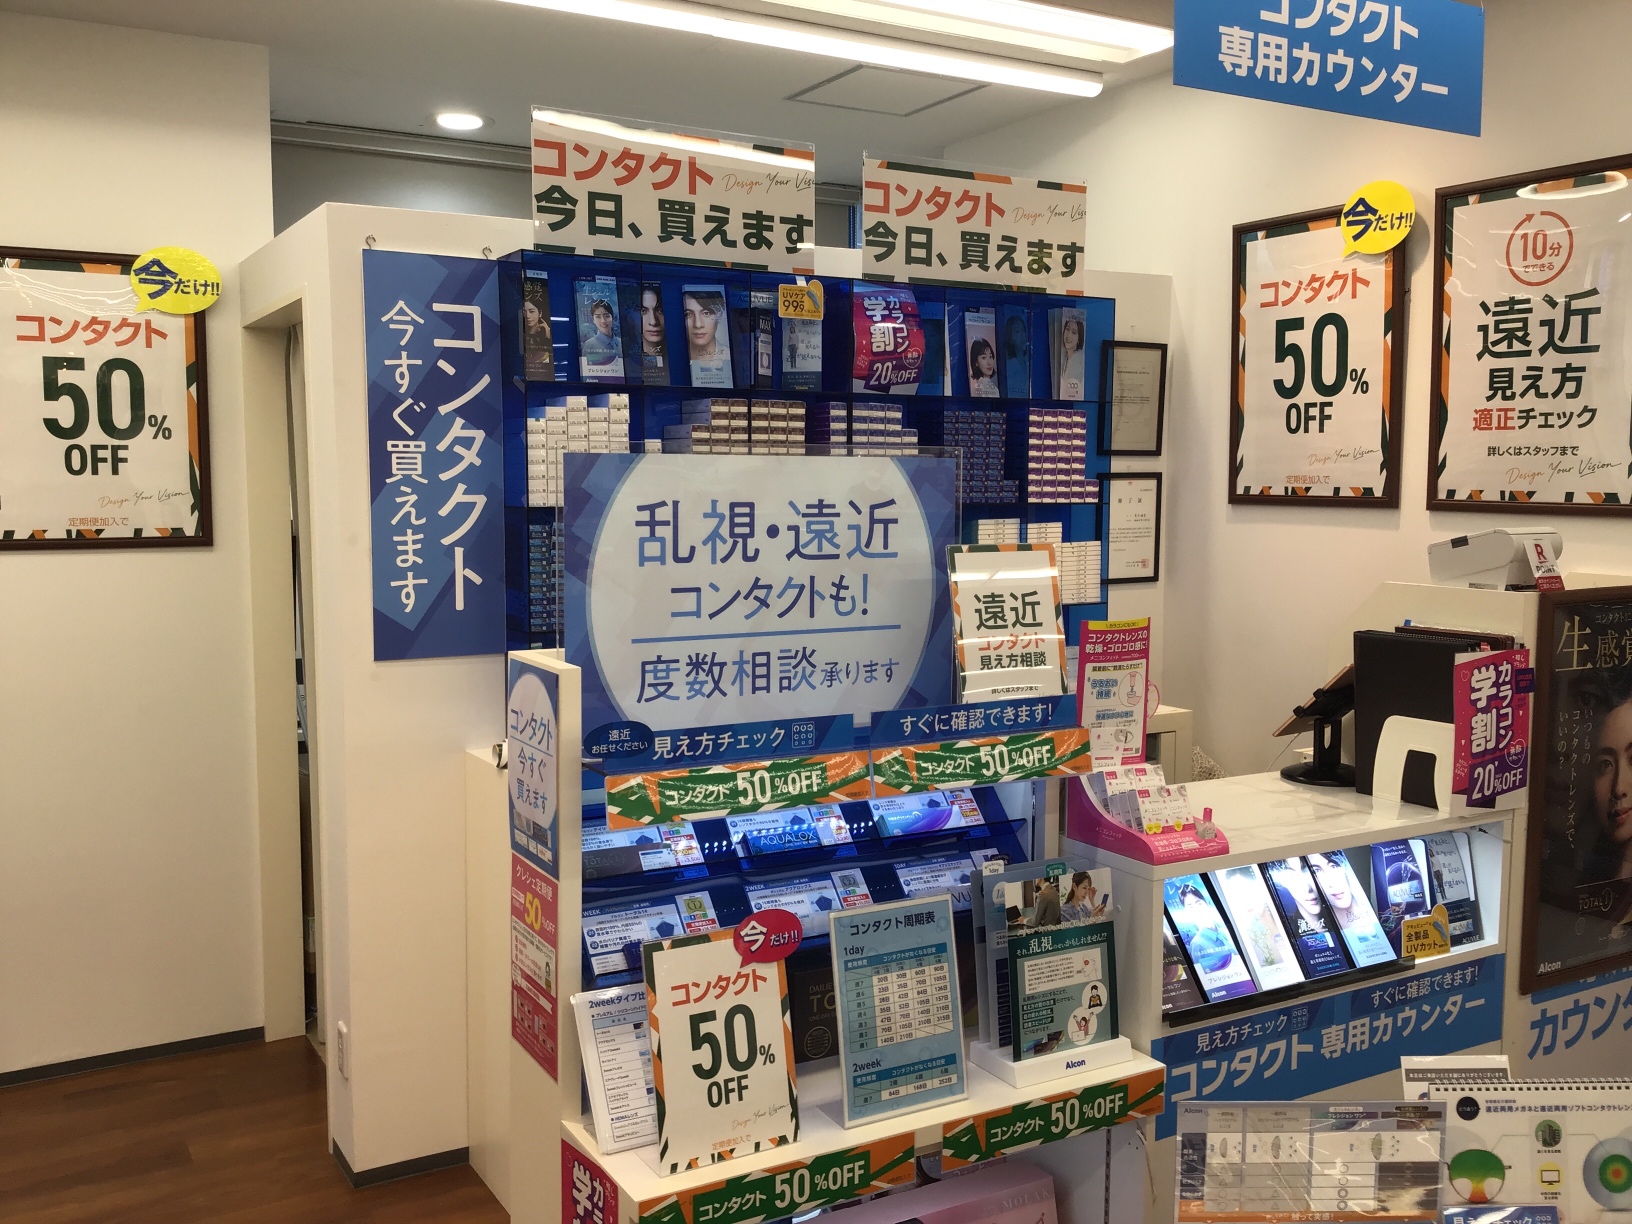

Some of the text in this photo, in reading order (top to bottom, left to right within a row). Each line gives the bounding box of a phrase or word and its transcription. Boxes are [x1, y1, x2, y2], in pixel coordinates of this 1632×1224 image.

[1218, 25, 1449, 103] 専用カウンター
[533, 138, 714, 195] コンタクト
[722, 173, 762, 195] Design
[764, 172, 791, 194] Your
[864, 181, 1006, 227] コンタクト
[1012, 206, 1044, 225] Design
[1046, 204, 1067, 224] Your
[534, 184, 815, 255] 今日、買えます
[864, 221, 1085, 278] 今日、買えます
[1519, 229, 1562, 262] 10分
[1522, 261, 1555, 272] でできる
[1260, 268, 1371, 309] コンタクト
[16, 314, 168, 349] コンタクト
[759, 319, 772, 331] MAX
[863, 296, 895, 352] 学割
[887, 295, 909, 352] カラコン
[1476, 287, 1602, 362] 遠近
[1485, 362, 1587, 403] 見え方
[1285, 401, 1334, 434] OFF
[1472, 405, 1598, 432] 適正チェック
[64, 443, 129, 476] OFF
[380, 299, 429, 614] 今すぐ買えます
[432, 301, 493, 611] コンタクト
[1308, 447, 1380, 466] Design Your Vision
[1487, 445, 1580, 457] 詳しくはスタッフまで
[1285, 474, 1330, 485] 定期便加入で
[1506, 458, 1622, 484] Design Your Vision
[99, 489, 190, 510] Design Your Vision
[68, 516, 129, 527] 定期便加入で
[635, 498, 899, 567] 乱視・遠近
[1535, 564, 1555, 574] POINT
[670, 573, 869, 620] コンタクトも!
[974, 590, 1043, 631] 遠近
[977, 631, 1046, 651] コンタクト
[1088, 630, 1148, 642] コンタクトレンズの
[636, 646, 900, 703] 度数相談承ります
[980, 651, 1047, 671] 見え方相談
[991, 685, 1039, 694] 詳しくはスタッフまで
[1470, 664, 1498, 755] 学割
[1498, 660, 1513, 750] カラコン
[511, 708, 553, 752] コンタクト
[900, 703, 1053, 736] すぐに確認できます!
[591, 741, 648, 755] お任せください
[608, 728, 631, 741] 遠近
[652, 726, 786, 760] 見え方チェック
[1582, 708, 1593, 764] いつもの
[518, 746, 547, 783] 今すぐ
[922, 757, 975, 776] コンタクト
[1564, 708, 1581, 850] コンタクトレンズで、
[516, 777, 548, 815] 買えます
[665, 785, 731, 805] コンタクト
[760, 831, 816, 846] AQUALOX
[894, 862, 907, 870] 1DAY
[516, 863, 553, 902] クレシェ定期便
[744, 883, 766, 892] 2WEEK
[850, 911, 936, 937] コンタクト周期表
[1406, 929, 1430, 943] 全製品
[843, 945, 865, 957] 1day
[1406, 940, 1438, 954] UVカット
[1462, 934, 1480, 944] ACUVUE
[883, 946, 937, 962] コンタクトがなくなる目安
[1537, 959, 1562, 974] Alcon
[670, 968, 768, 1007] コンタクト
[1211, 989, 1227, 999] Alcon
[1371, 965, 1479, 1009] すぐに確認できます!
[1171, 993, 1486, 1102] コンタクト 専用カウンター
[1196, 1014, 1288, 1054] 見え方チェック
[853, 1058, 882, 1073] 2week
[892, 1058, 946, 1076] コンタクトがなくなる目安
[1065, 1058, 1086, 1070] Alcon
[707, 1074, 749, 1109] OFF
[939, 1077, 953, 1085] 252日
[712, 1134, 752, 1151] 定期便加入で
[990, 1117, 1045, 1144] コンタクト
[699, 1191, 767, 1222] コンタクト
